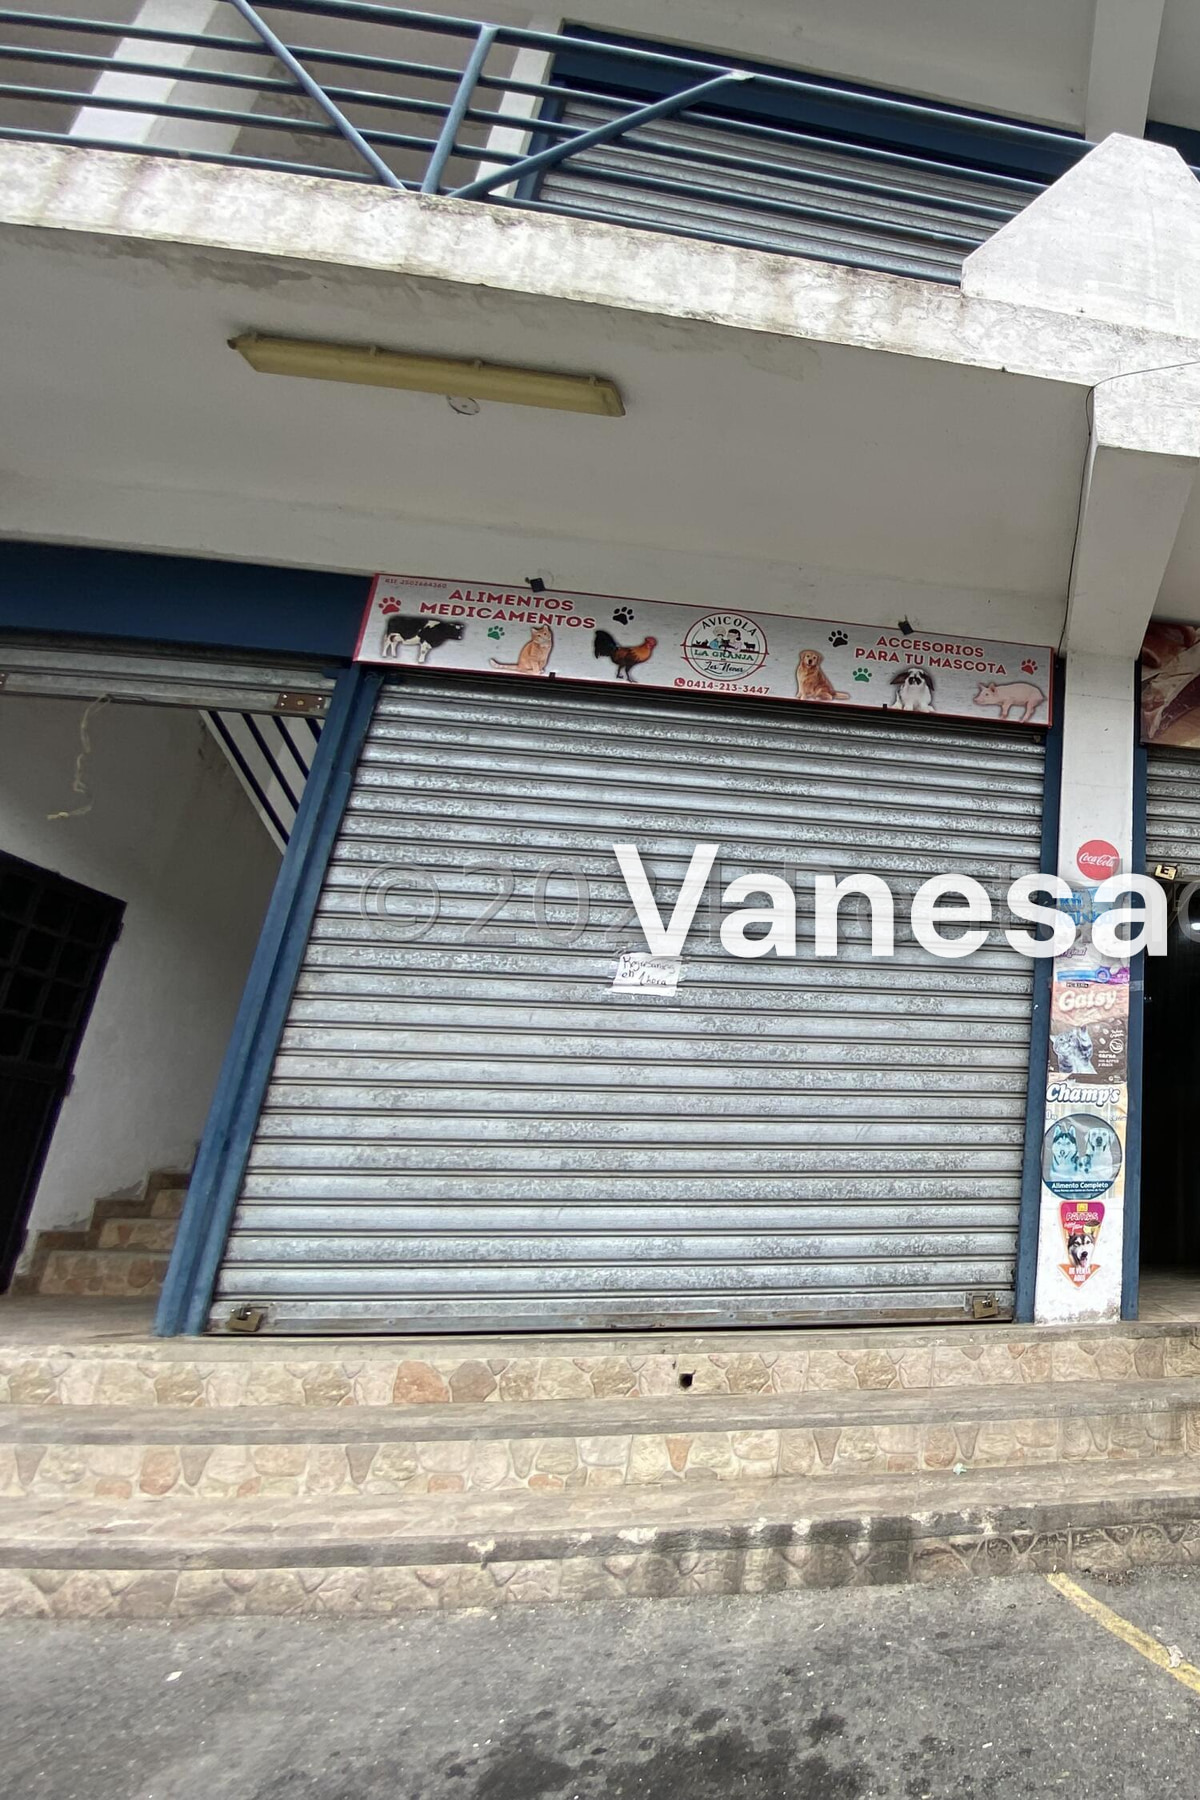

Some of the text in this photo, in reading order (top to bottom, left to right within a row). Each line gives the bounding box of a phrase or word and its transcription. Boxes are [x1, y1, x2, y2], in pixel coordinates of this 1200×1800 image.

[448, 588, 575, 612] ALIMENTOS
[419, 601, 597, 630] MEDICAMENTOS
[702, 616, 757, 637] AVICOLA
[694, 649, 755, 661] LA GRANJA
[876, 635, 985, 659] ACCESORIOS
[855, 647, 1007, 676] PARA TU MASCOTA
[686, 679, 770, 695] 0414-213-3447
[1046, 1083, 1121, 1108] Champ's
[1080, 1182, 1109, 1190] Completo
